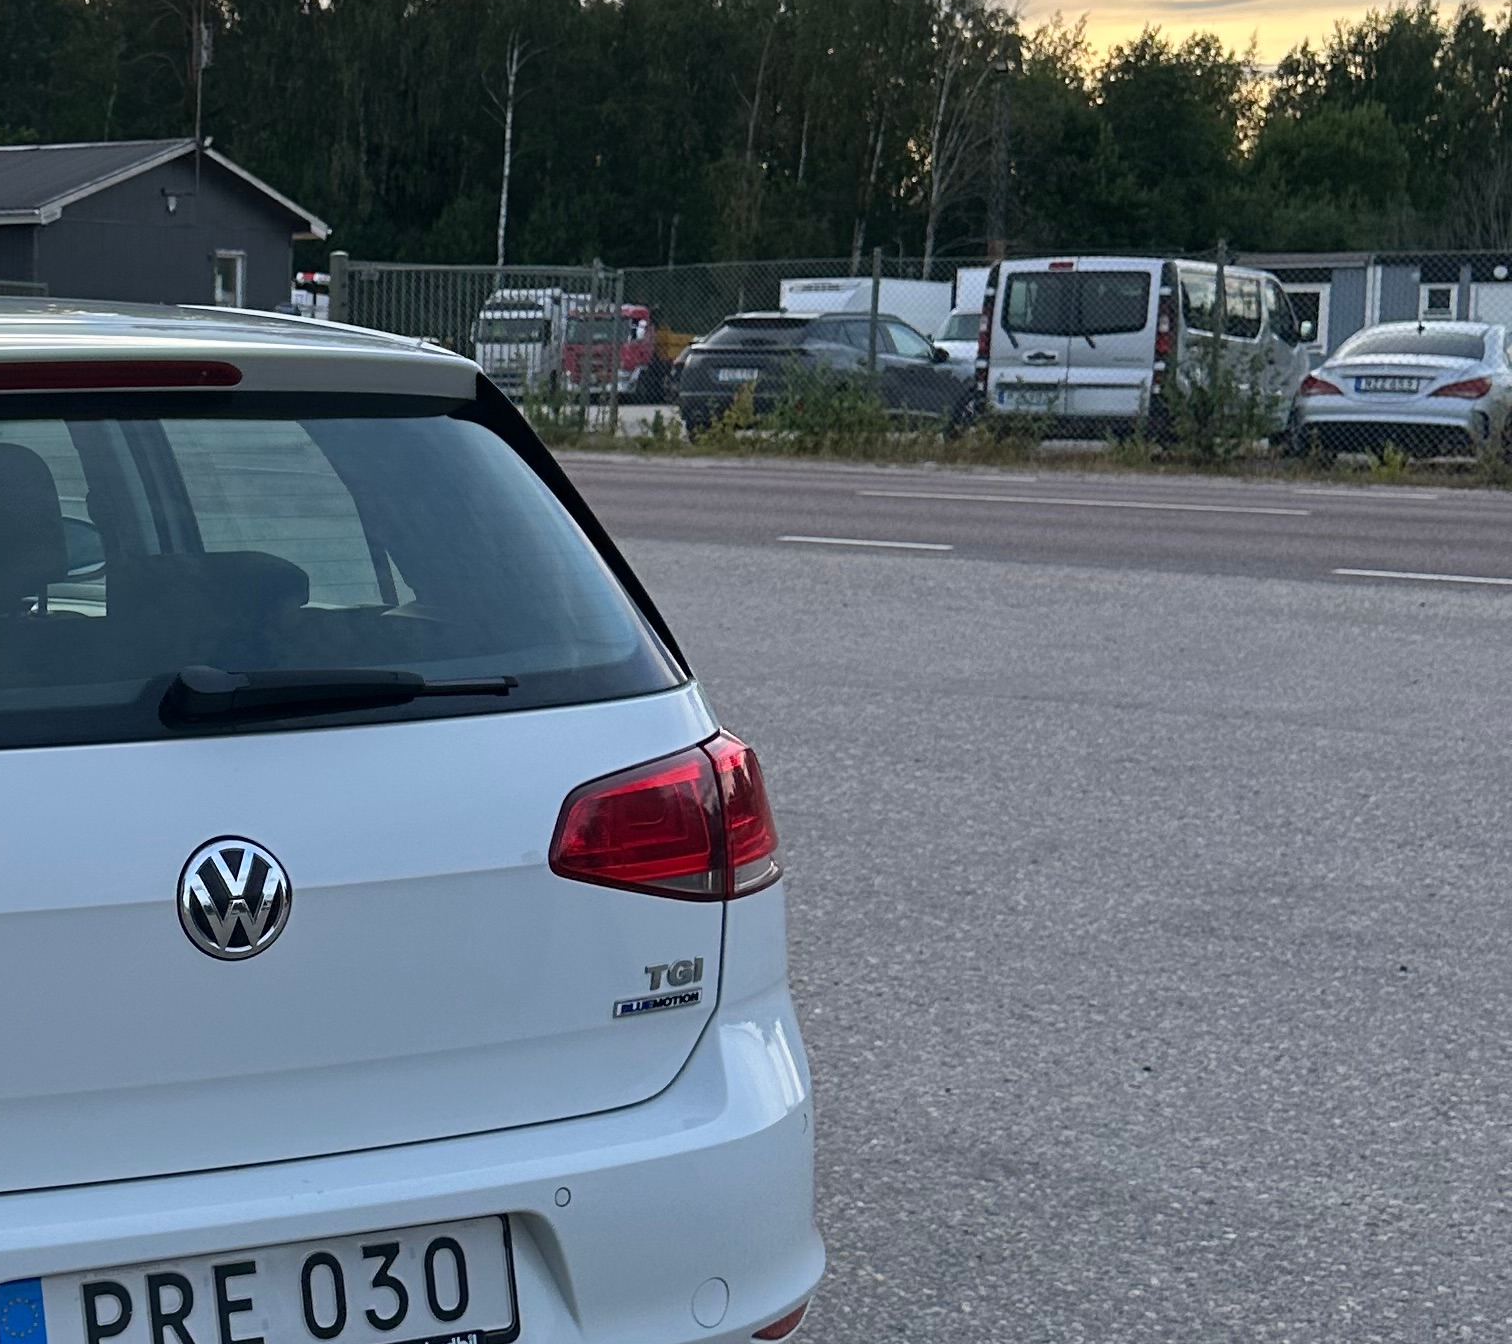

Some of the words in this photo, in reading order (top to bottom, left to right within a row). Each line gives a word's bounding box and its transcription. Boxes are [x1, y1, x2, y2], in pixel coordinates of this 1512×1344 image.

[187, 844, 283, 952] VW
[645, 957, 704, 991] TGI
[301, 1237, 469, 1339] 030
